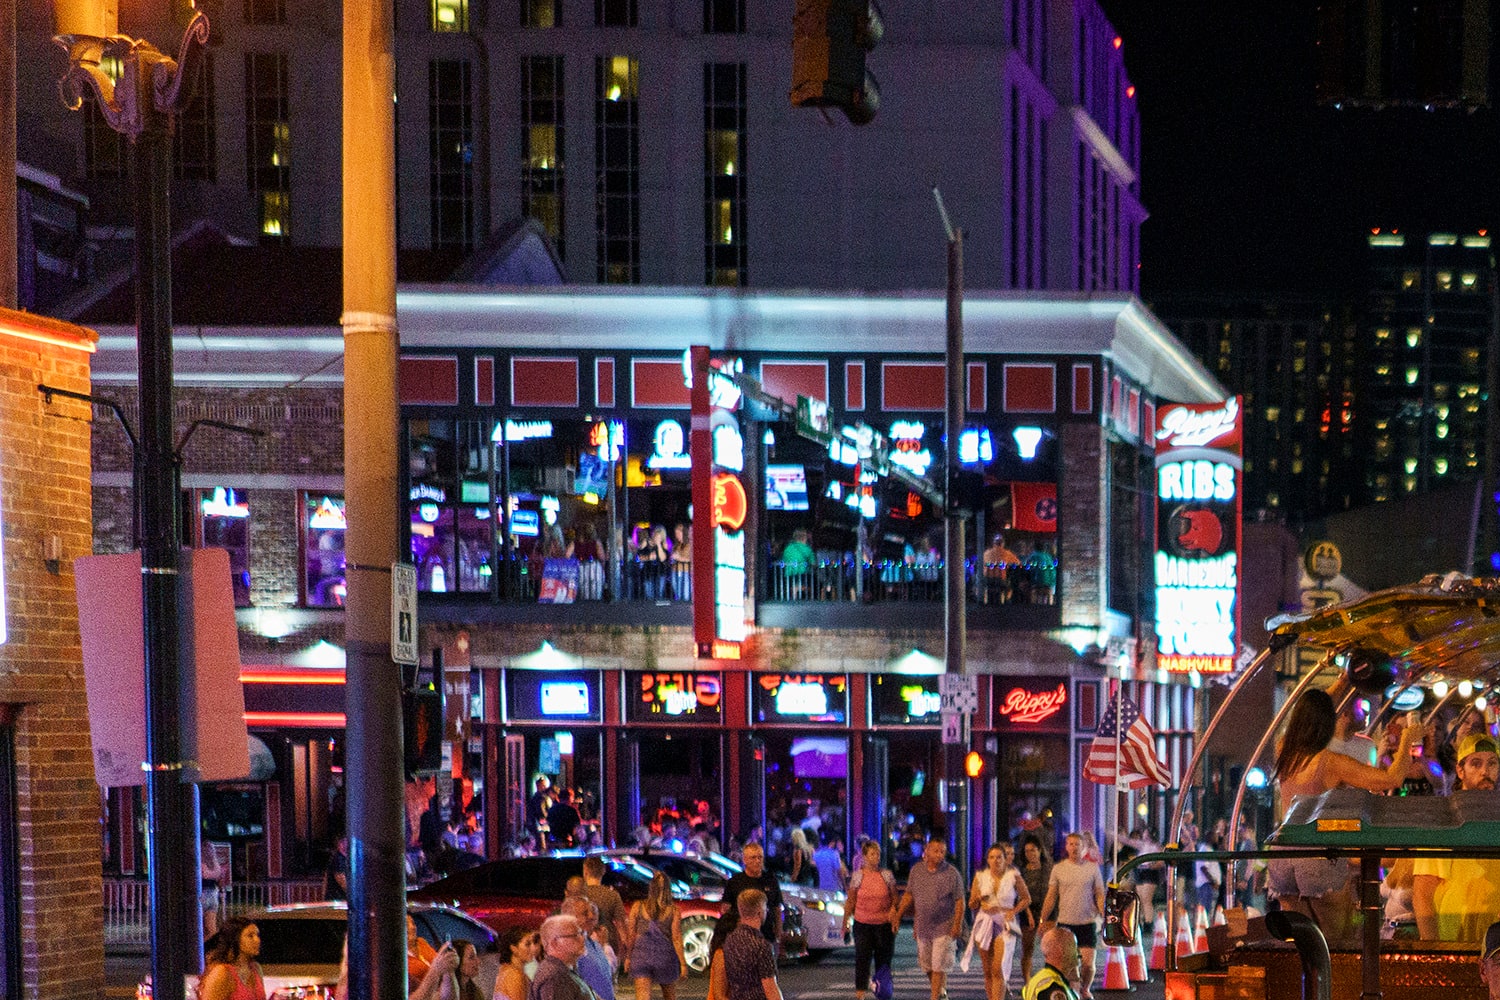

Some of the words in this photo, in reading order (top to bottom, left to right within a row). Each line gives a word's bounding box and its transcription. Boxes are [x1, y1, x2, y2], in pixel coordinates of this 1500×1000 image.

[1155, 396, 1238, 447] Rippy's
[1158, 460, 1236, 500] RIBS
[1158, 655, 1234, 672] NASHVILLE
[1001, 683, 1067, 718] Rippy's
